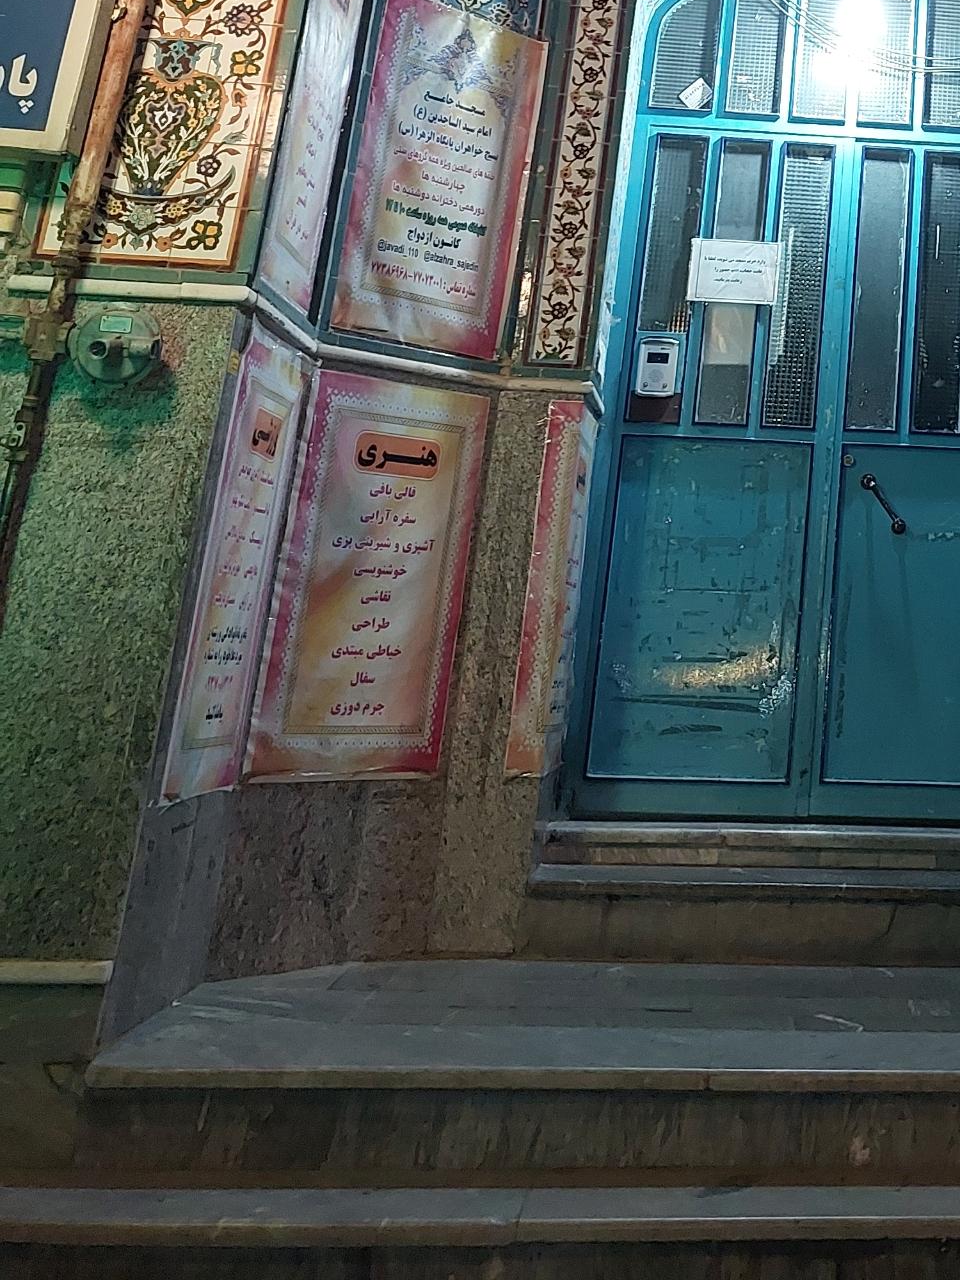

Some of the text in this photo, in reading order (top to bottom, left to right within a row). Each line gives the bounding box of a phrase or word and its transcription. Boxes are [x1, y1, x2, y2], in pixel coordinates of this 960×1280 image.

[428, 112, 461, 128] الساجدین
[462, 123, 475, 134] سید
[476, 125, 492, 137] امام
[455, 141, 483, 157] خواهران
[357, 444, 438, 469] هنری
[369, 482, 416, 500] قالی بافی
[360, 509, 417, 527] سفره آرایی
[332, 535, 436, 554] آشپزی و شیرینی پزی
[354, 564, 407, 579] خوشنویسی
[360, 590, 391, 605] نقاشی
[352, 617, 390, 632] طراحی
[331, 644, 402, 660] خیاطی مبتدی
[350, 672, 375, 687] سفال
[331, 701, 384, 715] چرم دوزی
